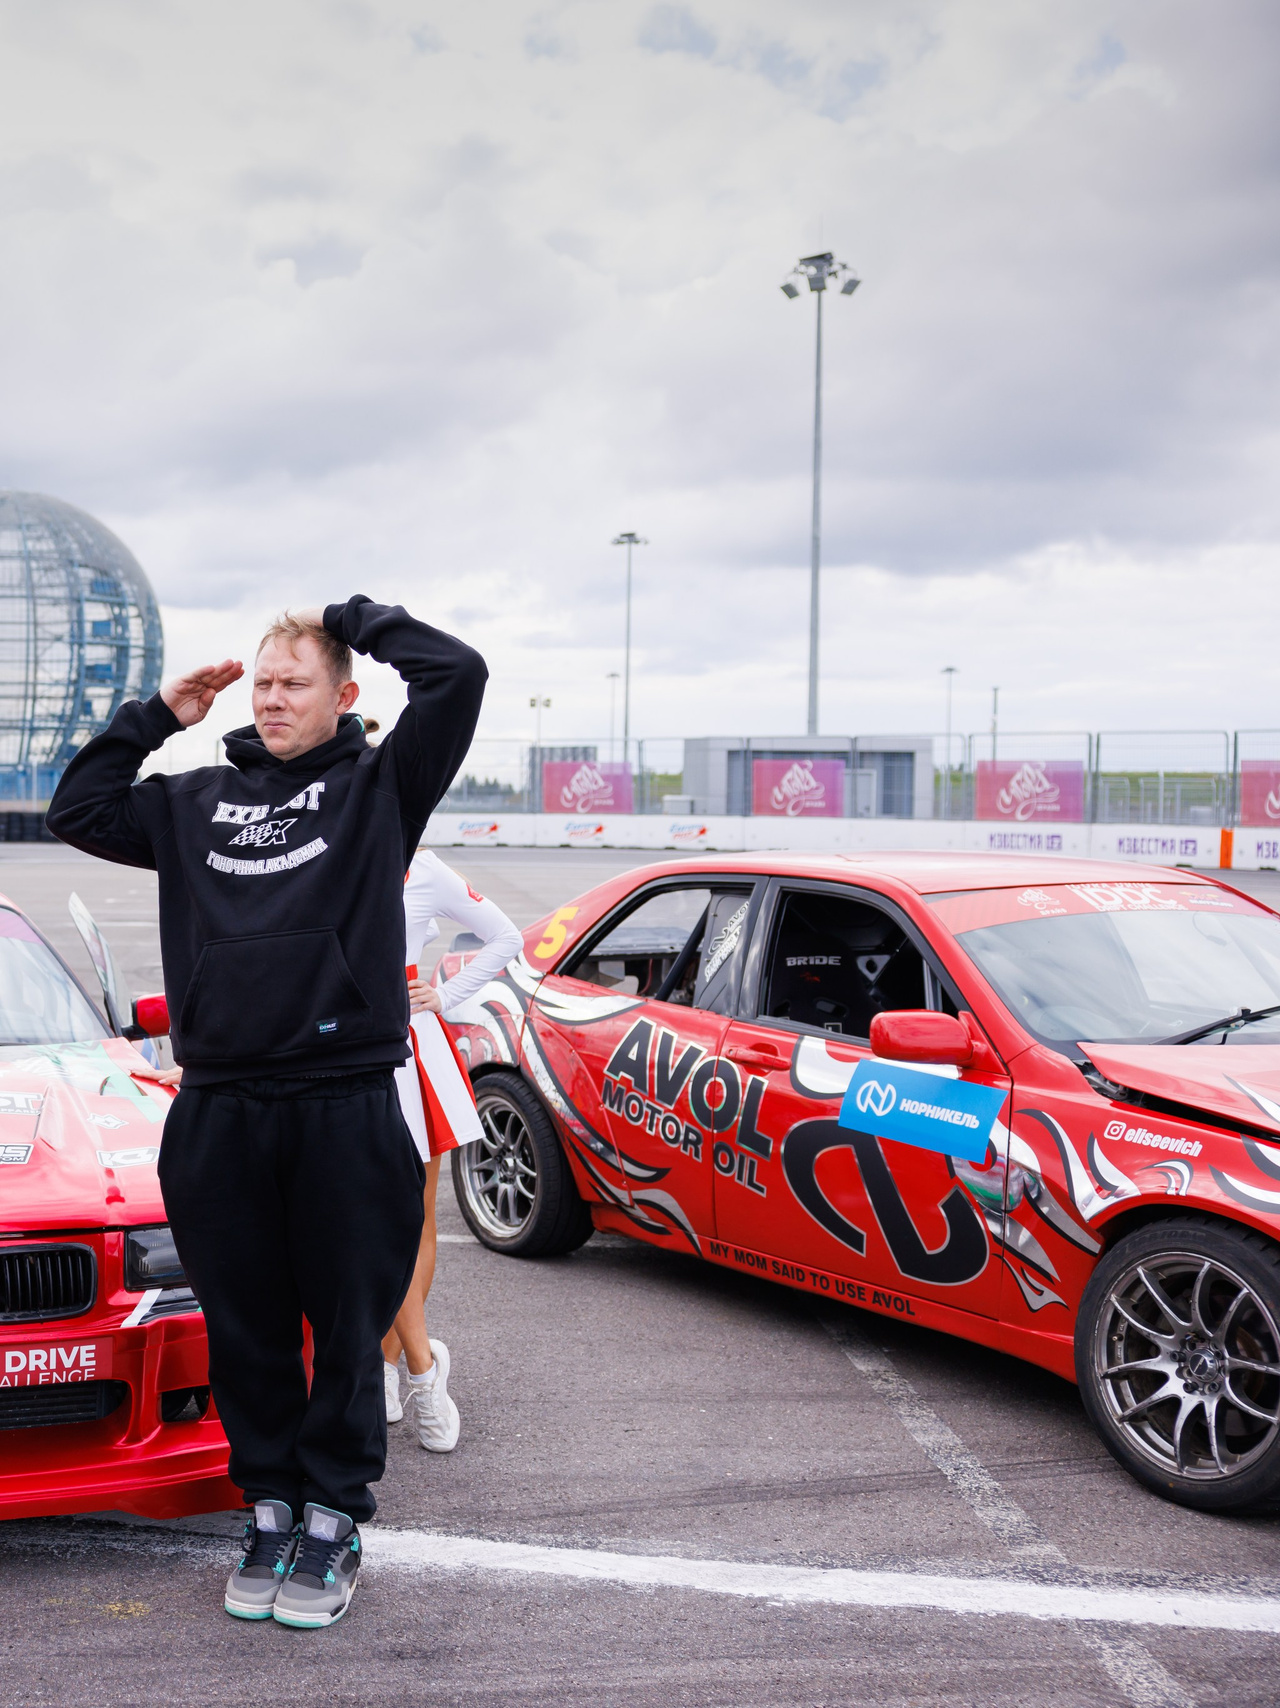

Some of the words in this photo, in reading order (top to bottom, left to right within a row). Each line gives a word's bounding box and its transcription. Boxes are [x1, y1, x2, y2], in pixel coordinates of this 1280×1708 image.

[206, 850, 265, 875] ГОНОЧНАЯ
[265, 837, 328, 875] АКАДЕМИЯ
[1118, 837, 1176, 855] ИЗВЕСТИЯ
[533, 906, 579, 959] 5
[786, 955, 841, 967] BRIDE
[603, 1016, 773, 1162] AVOL
[900, 1098, 980, 1129] НОРНИКЕЛЬ
[602, 1077, 704, 1163] MOTOR
[713, 1141, 767, 1198] OIL
[1124, 1127, 1203, 1157] eliseevich
[710, 1241, 729, 1259] MY
[734, 1249, 768, 1271] MOM
[772, 1261, 805, 1282] SAID
[810, 1272, 830, 1291] TO
[835, 1281, 867, 1301] USE
[872, 1290, 915, 1316] AVOL
[5, 1344, 96, 1373] DRIVE
